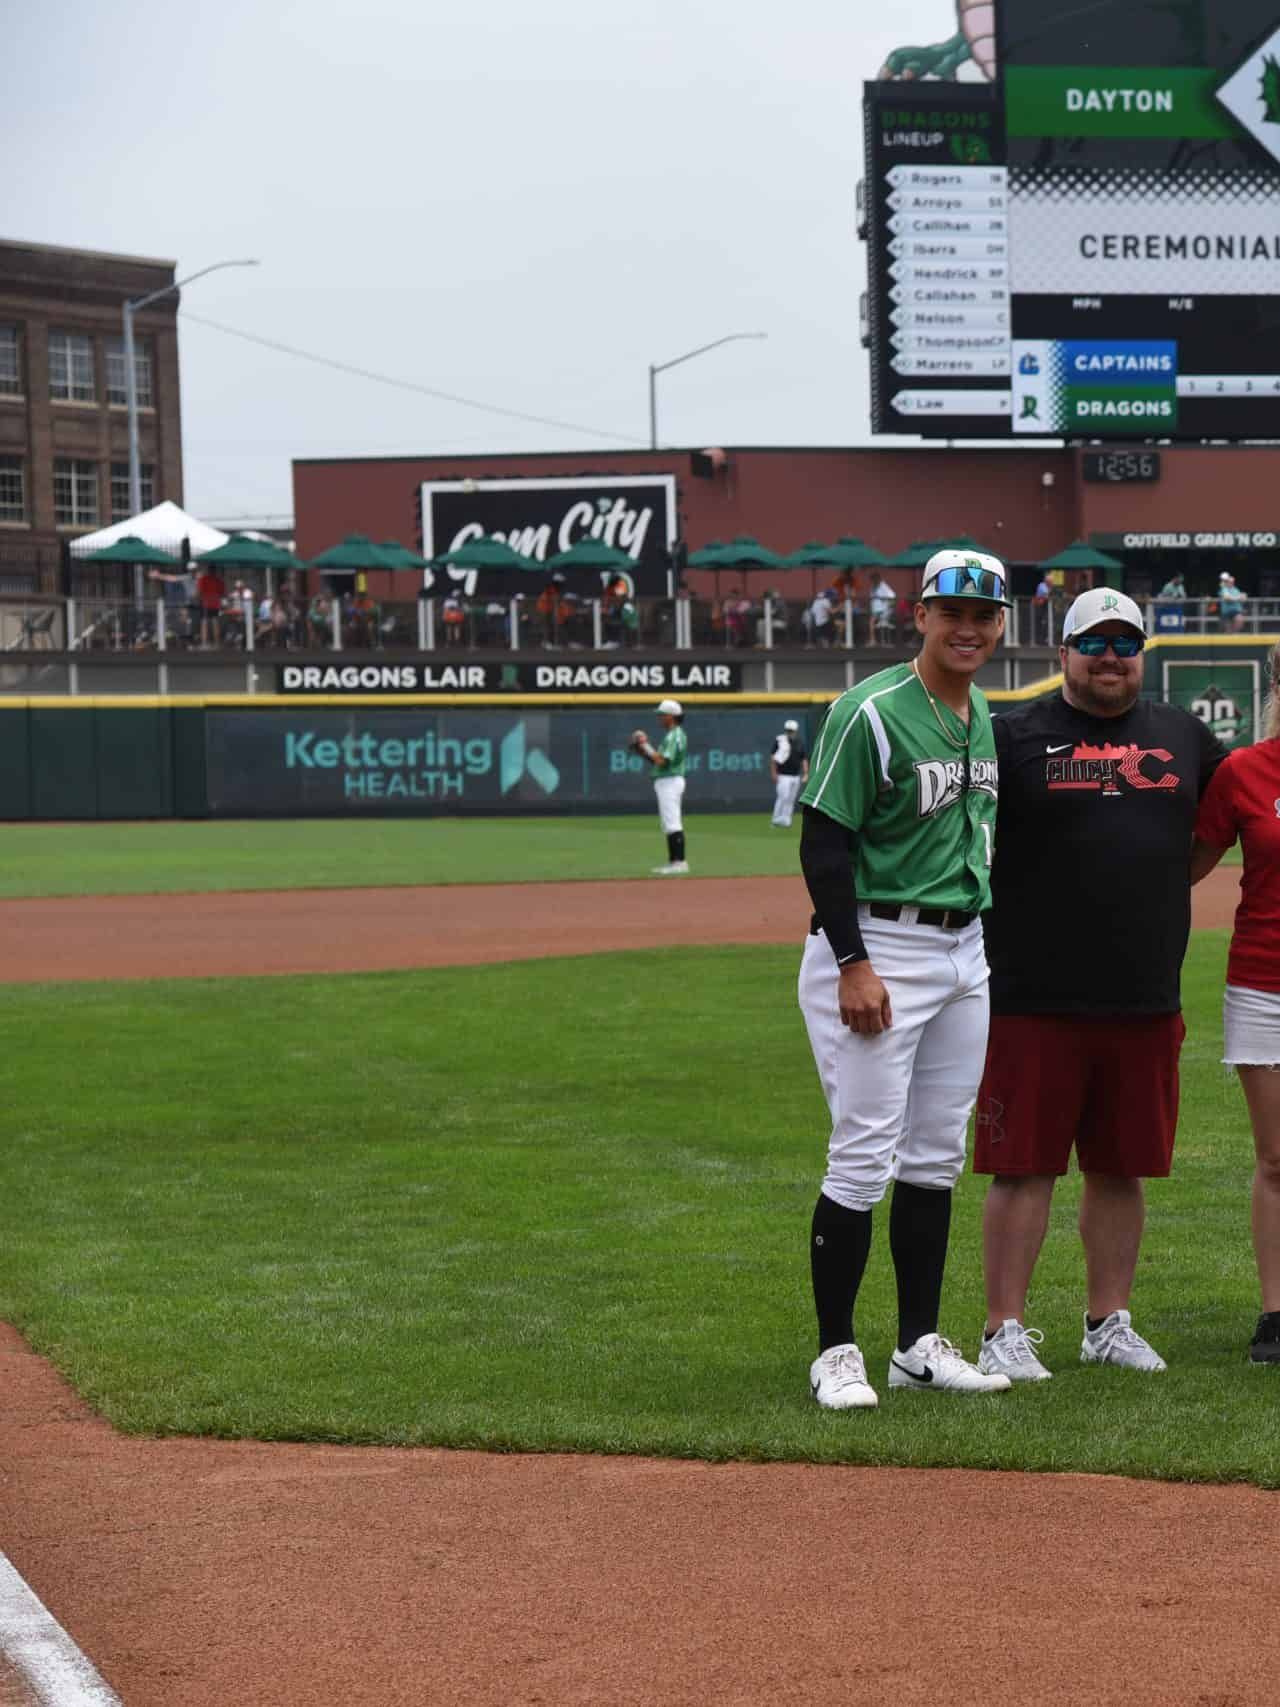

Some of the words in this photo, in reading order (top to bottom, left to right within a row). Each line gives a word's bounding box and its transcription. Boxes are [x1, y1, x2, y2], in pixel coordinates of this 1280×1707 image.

[1065, 89, 1174, 112] DAYTON
[881, 112, 990, 127] DRAGONS
[882, 131, 944, 147] LINEUP
[911, 173, 962, 186] Rogers
[912, 197, 962, 210] Arroyo
[913, 244, 956, 255] Ibarra
[913, 268, 978, 280] Hendrick
[914, 289, 977, 302] Callahan
[916, 336, 991, 350] Thompson
[916, 359, 974, 371] Marrero
[1074, 354, 1172, 371] CAPTAINS
[1076, 401, 1172, 416] DRAGONS
[1098, 456, 1152, 477] 12:56
[1123, 533, 1189, 547] OUTFIELD
[1194, 533, 1234, 547] GRAB
[1252, 533, 1276, 546] GO
[283, 666, 417, 688] DRAGONS
[424, 666, 485, 688] LAIR
[536, 666, 664, 687] DRAGONS
[671, 665, 730, 687] LAIR
[284, 731, 493, 774] Kettering
[610, 750, 643, 772] Be
[708, 750, 762, 770] Best
[344, 773, 464, 797] HEALTH
[914, 760, 998, 818] DRAGON
